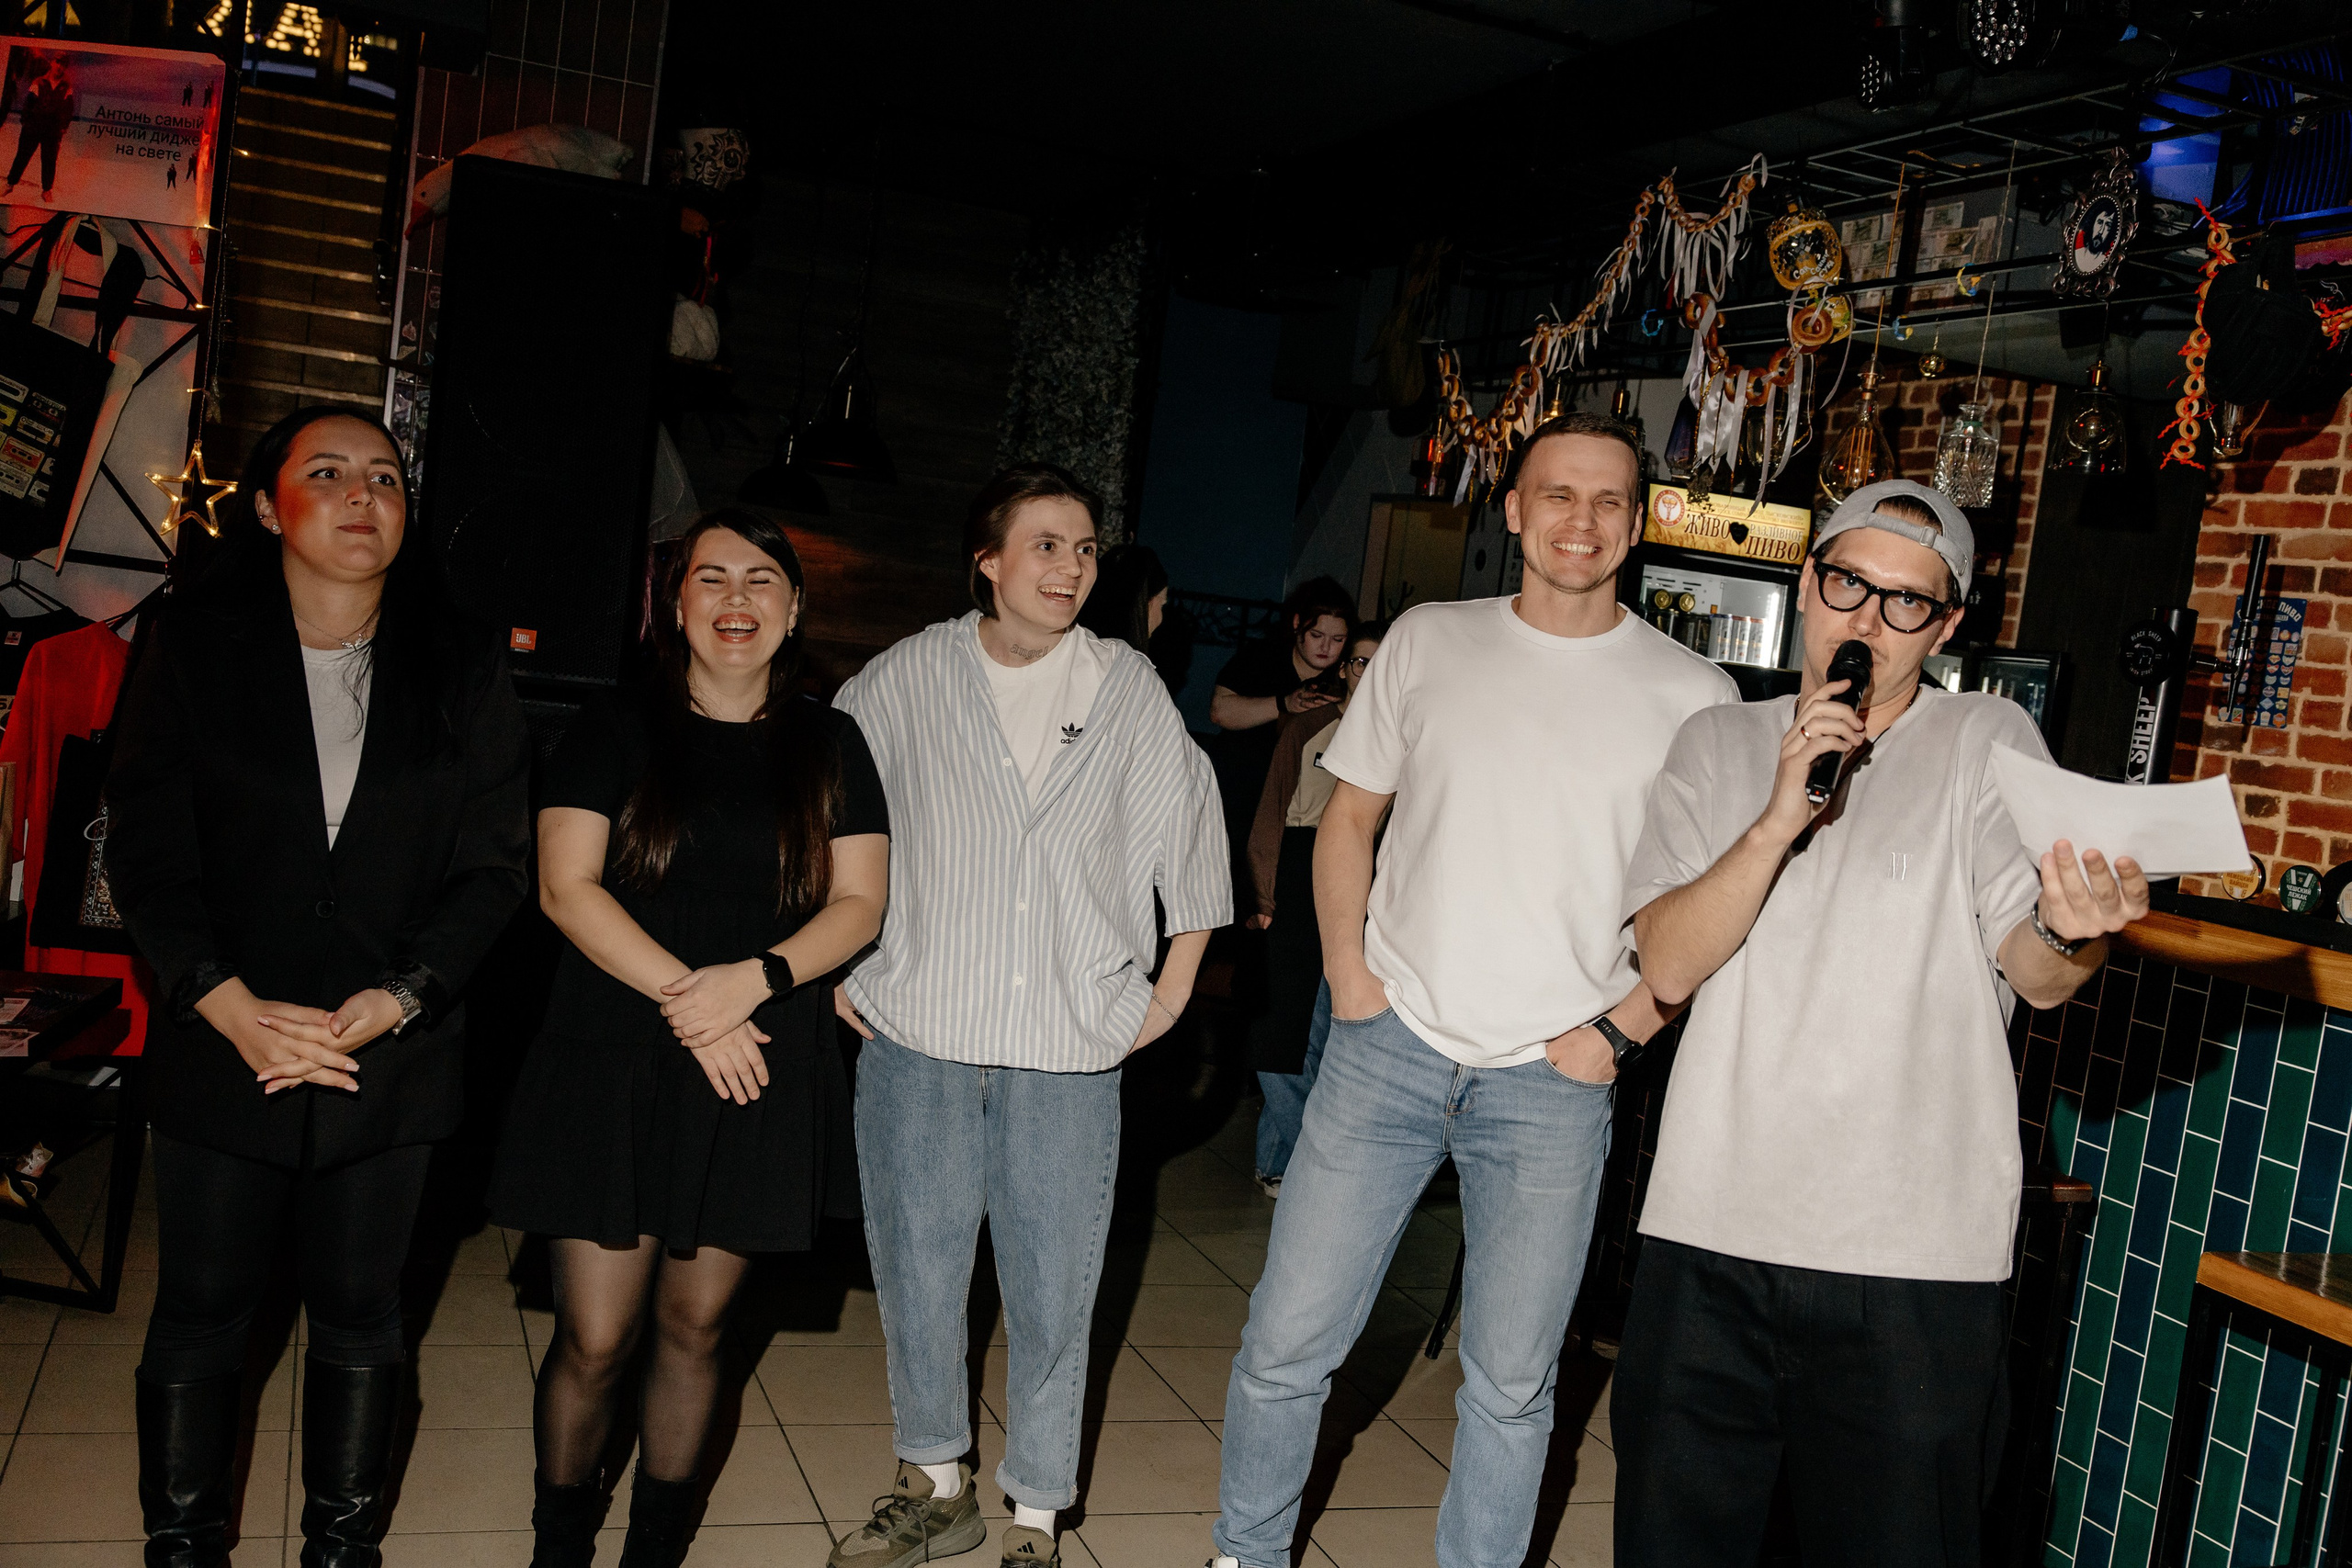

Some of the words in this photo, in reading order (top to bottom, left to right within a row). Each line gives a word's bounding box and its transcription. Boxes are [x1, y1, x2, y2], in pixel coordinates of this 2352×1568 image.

[155, 114, 204, 129] самый
[87, 124, 147, 141] лучший
[149, 131, 200, 147] дидже
[116, 143, 133, 156] на
[138, 146, 181, 162] свете
[1684, 513, 1732, 539] ЖИВО
[1750, 524, 1804, 542] РАЗЛИВНОЕ
[1746, 536, 1801, 561] ПИВО
[2278, 602, 2302, 622] ПИВО
[515, 633, 532, 644] JBL
[1010, 643, 1049, 660] angel
[2131, 697, 2156, 764] SHEEP
[2286, 884, 2312, 895] ЧЕШСКИЙ
[2288, 891, 2308, 901] ЛЕЖАК
